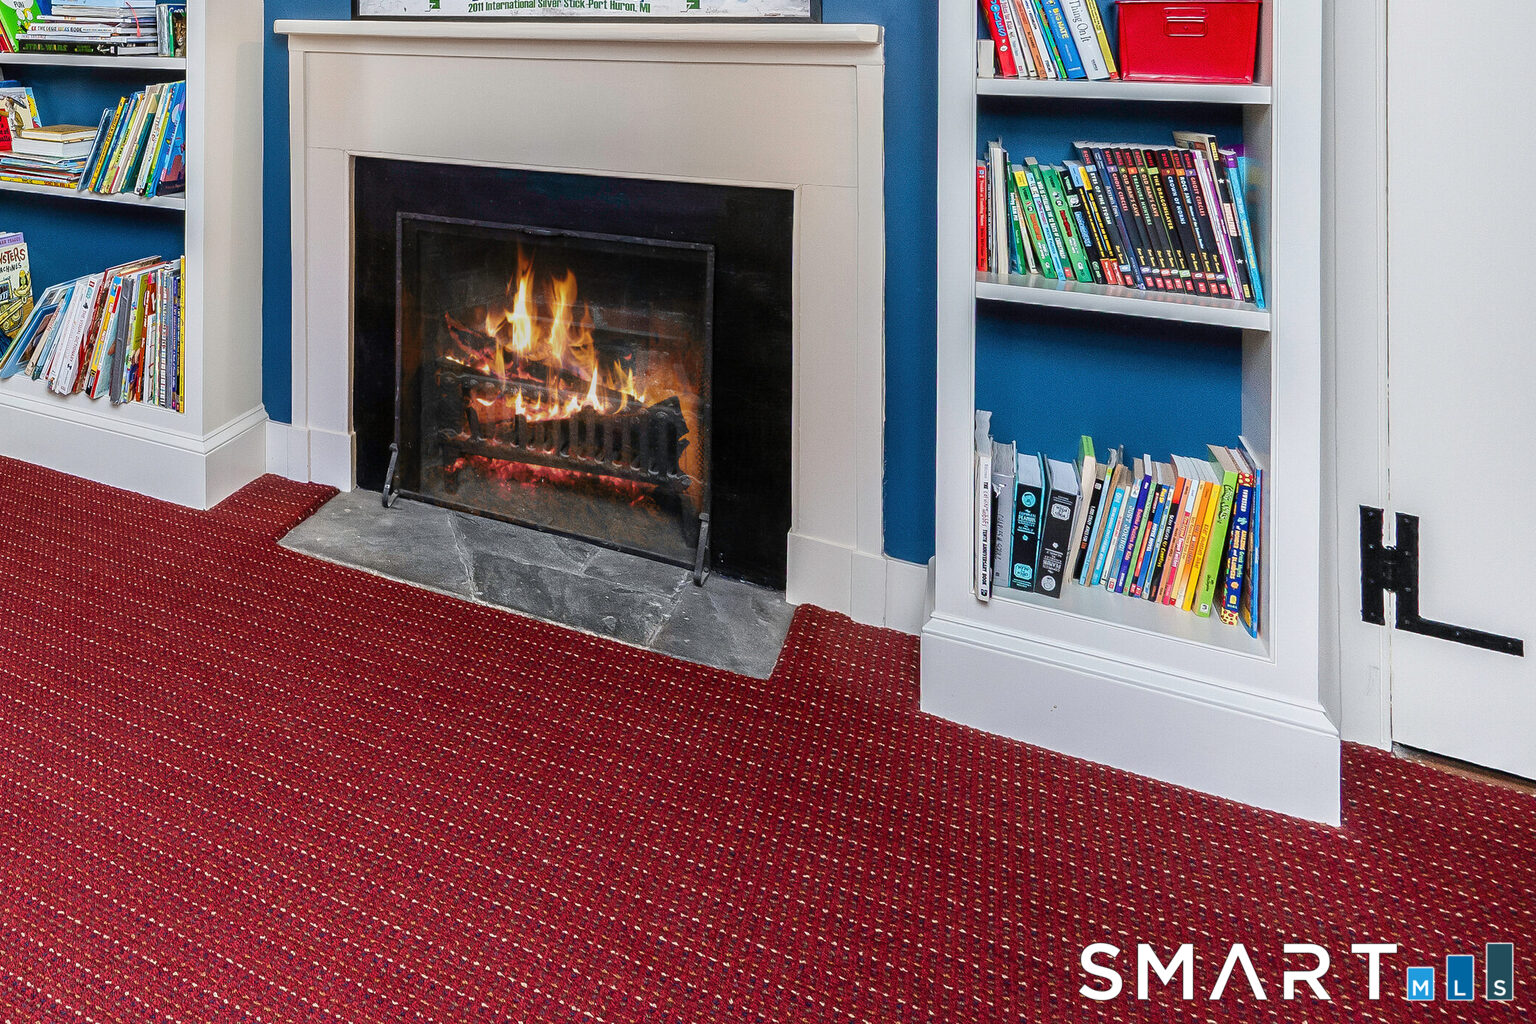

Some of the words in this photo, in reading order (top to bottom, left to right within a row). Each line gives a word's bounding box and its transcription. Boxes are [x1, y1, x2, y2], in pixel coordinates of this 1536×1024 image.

[468, 3, 484, 13] 2011
[485, 0, 536, 11] International
[639, 2, 651, 13] MI
[1052, 7, 1062, 20] BIG
[1056, 20, 1068, 39] NATE
[1075, 21, 1090, 36] On
[45, 43, 67, 51] WARS
[1080, 34, 1092, 43] It
[1111, 172, 1121, 191] GHOST
[1117, 191, 1128, 211] CIRCLES
[1167, 175, 1177, 196] CROWN
[1179, 175, 1188, 192] ROCK
[1132, 174, 1144, 201] TREASURE
[1140, 201, 1152, 226] HUNTERS
[1141, 173, 1149, 185] OLD
[1151, 203, 1159, 217] CAVE
[1173, 196, 1180, 205] OF
[1183, 191, 1192, 204] JAW
[1190, 176, 1200, 195] GHOST
[1196, 195, 1206, 216] CIRCLES
[1101, 205, 1111, 224] STORM
[1131, 203, 1140, 217] CAVE
[1157, 187, 1173, 230] DRAGONSLAYER
[1176, 205, 1186, 225] HORNS
